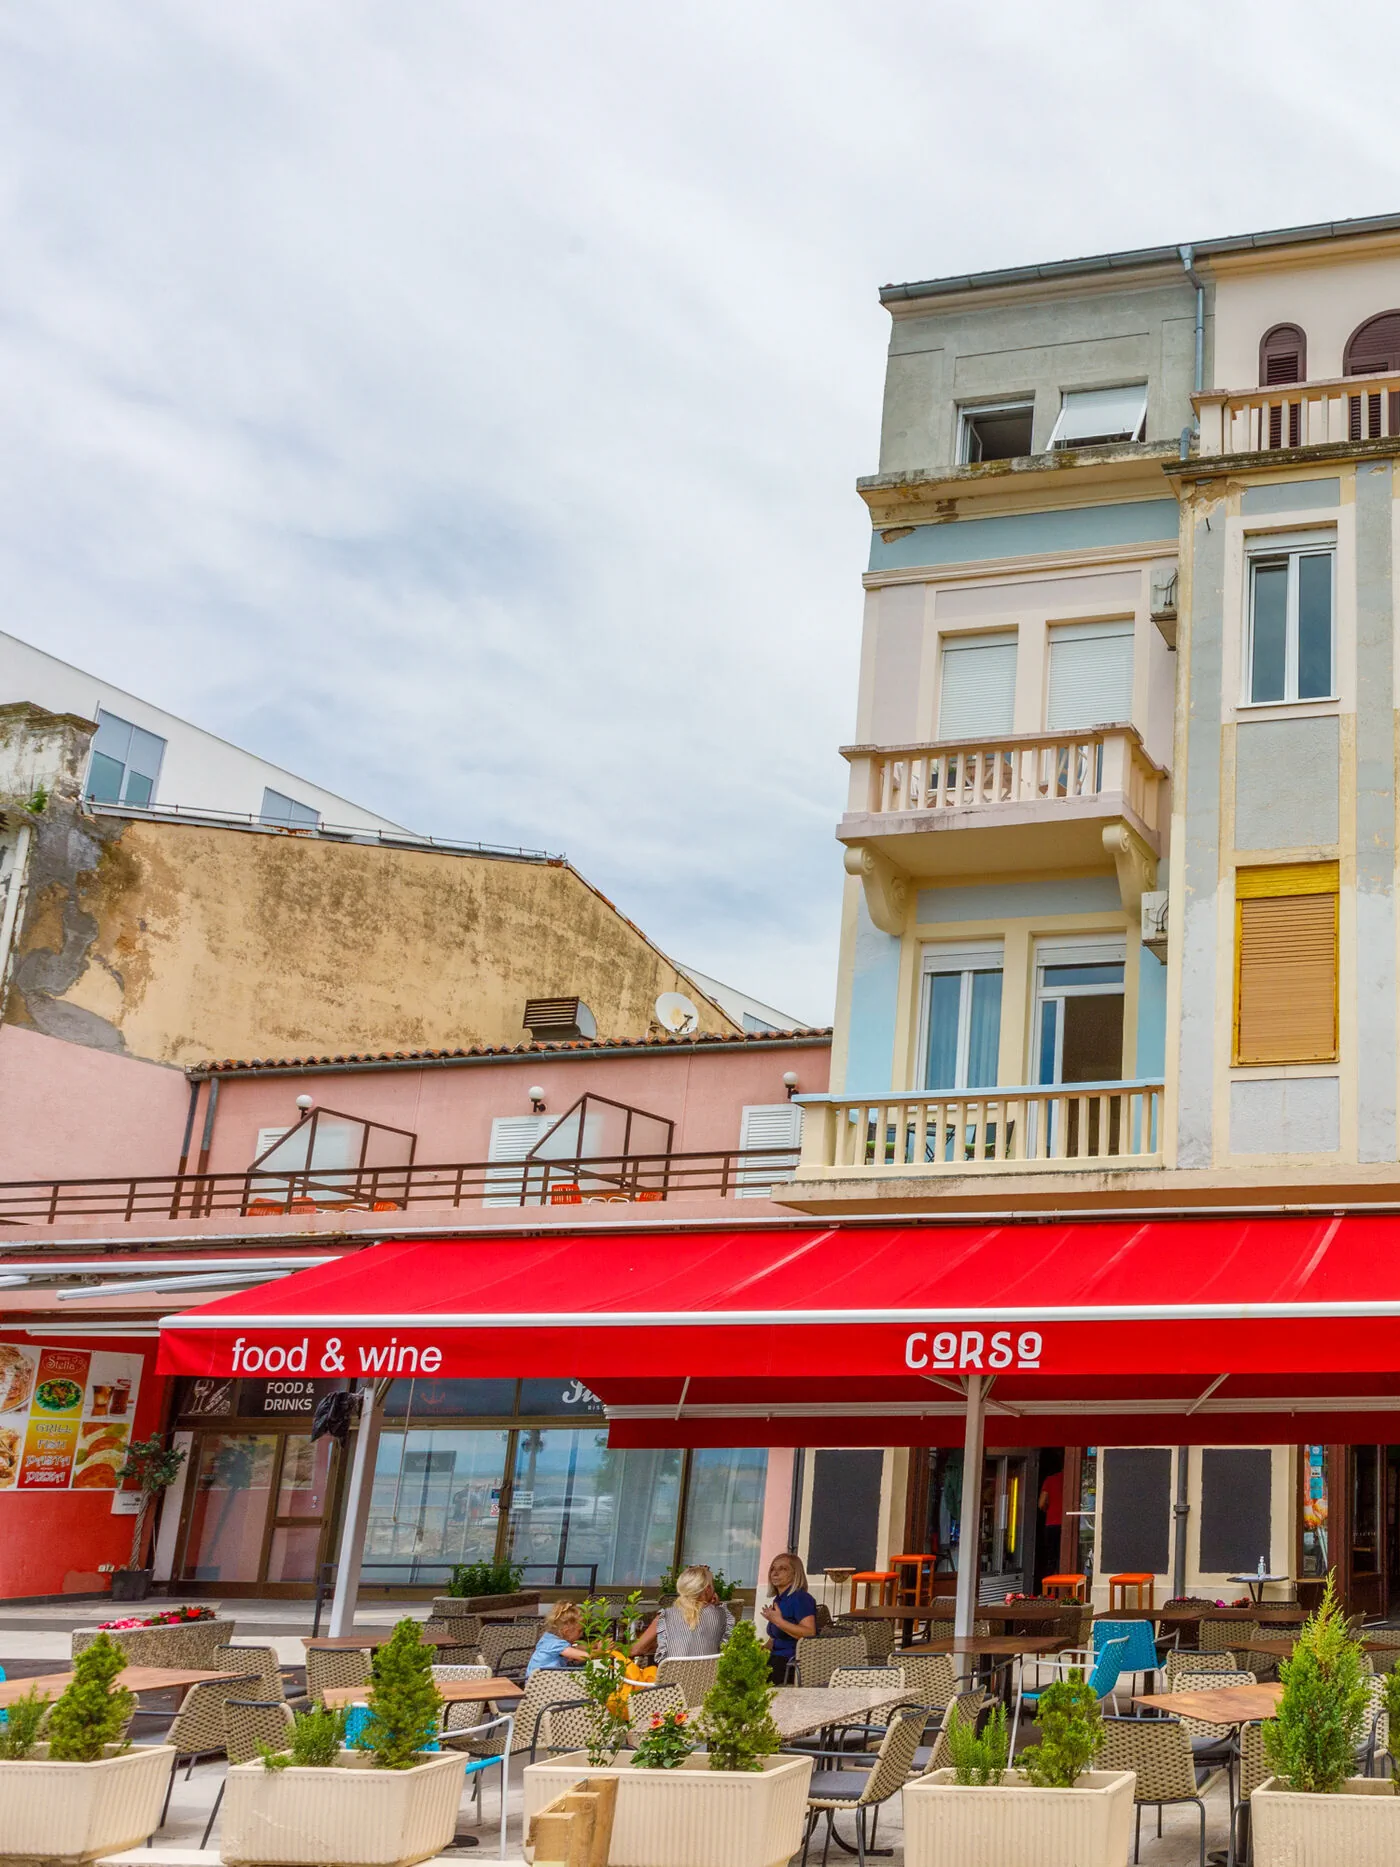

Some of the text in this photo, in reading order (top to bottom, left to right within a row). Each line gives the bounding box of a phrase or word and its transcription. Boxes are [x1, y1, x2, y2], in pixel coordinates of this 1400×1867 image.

[231, 1337, 442, 1372] food & wine
[905, 1331, 1043, 1368] CORSO
[266, 1382, 314, 1394] FOOD &
[264, 1398, 312, 1411] DRINKS
